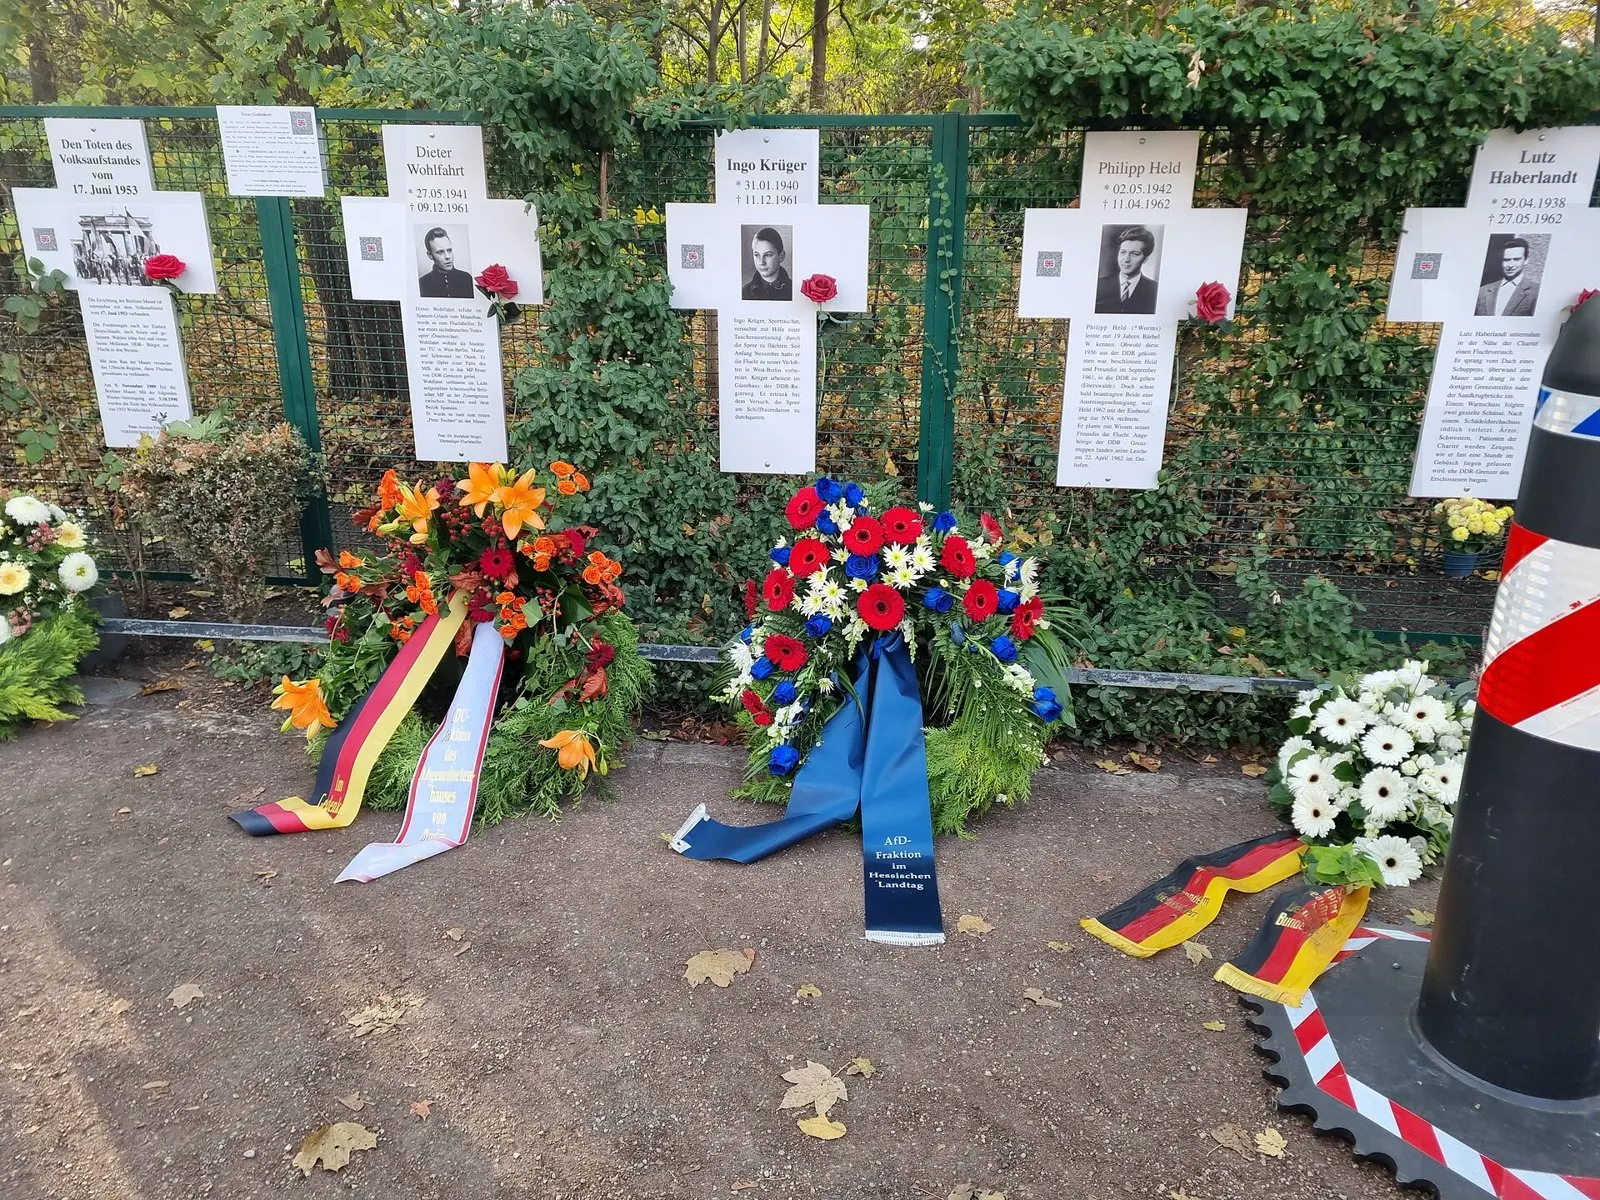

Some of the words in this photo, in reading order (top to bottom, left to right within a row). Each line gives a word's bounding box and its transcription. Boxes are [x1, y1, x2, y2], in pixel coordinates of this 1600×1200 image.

[61, 139, 81, 149] Den
[84, 140, 113, 149] Toten
[116, 140, 132, 150] des
[416, 146, 452, 158] Dieter
[1520, 150, 1556, 164] Lutz
[59, 154, 140, 165] Volksaufstandes
[406, 164, 464, 176] Wohlfahrt
[727, 159, 756, 174] Ingo
[760, 159, 807, 174] Krüger
[1099, 162, 1145, 177] Philipp
[1150, 162, 1181, 174] Held
[1489, 170, 1577, 184] Haberlandt
[73, 184, 87, 194] 17.
[91, 185, 112, 195] Juni
[115, 186, 138, 195] 1953
[745, 180, 798, 190] 31.01.1940
[1113, 184, 1172, 194] 02.05.1942
[416, 189, 467, 199] 27.05.1941
[746, 195, 797, 204] 11.12.1961
[417, 202, 468, 213] 09.12.1961
[1113, 199, 1170, 209] 11.04.1962
[1501, 198, 1567, 209] 29.04.1938
[1498, 213, 1562, 224] 27.05.1962
[430, 786, 456, 803] hauses
[432, 813, 447, 824] von
[884, 835, 912, 846] AfD-
[876, 851, 921, 859] Fraktion
[878, 881, 924, 890] Landtag
